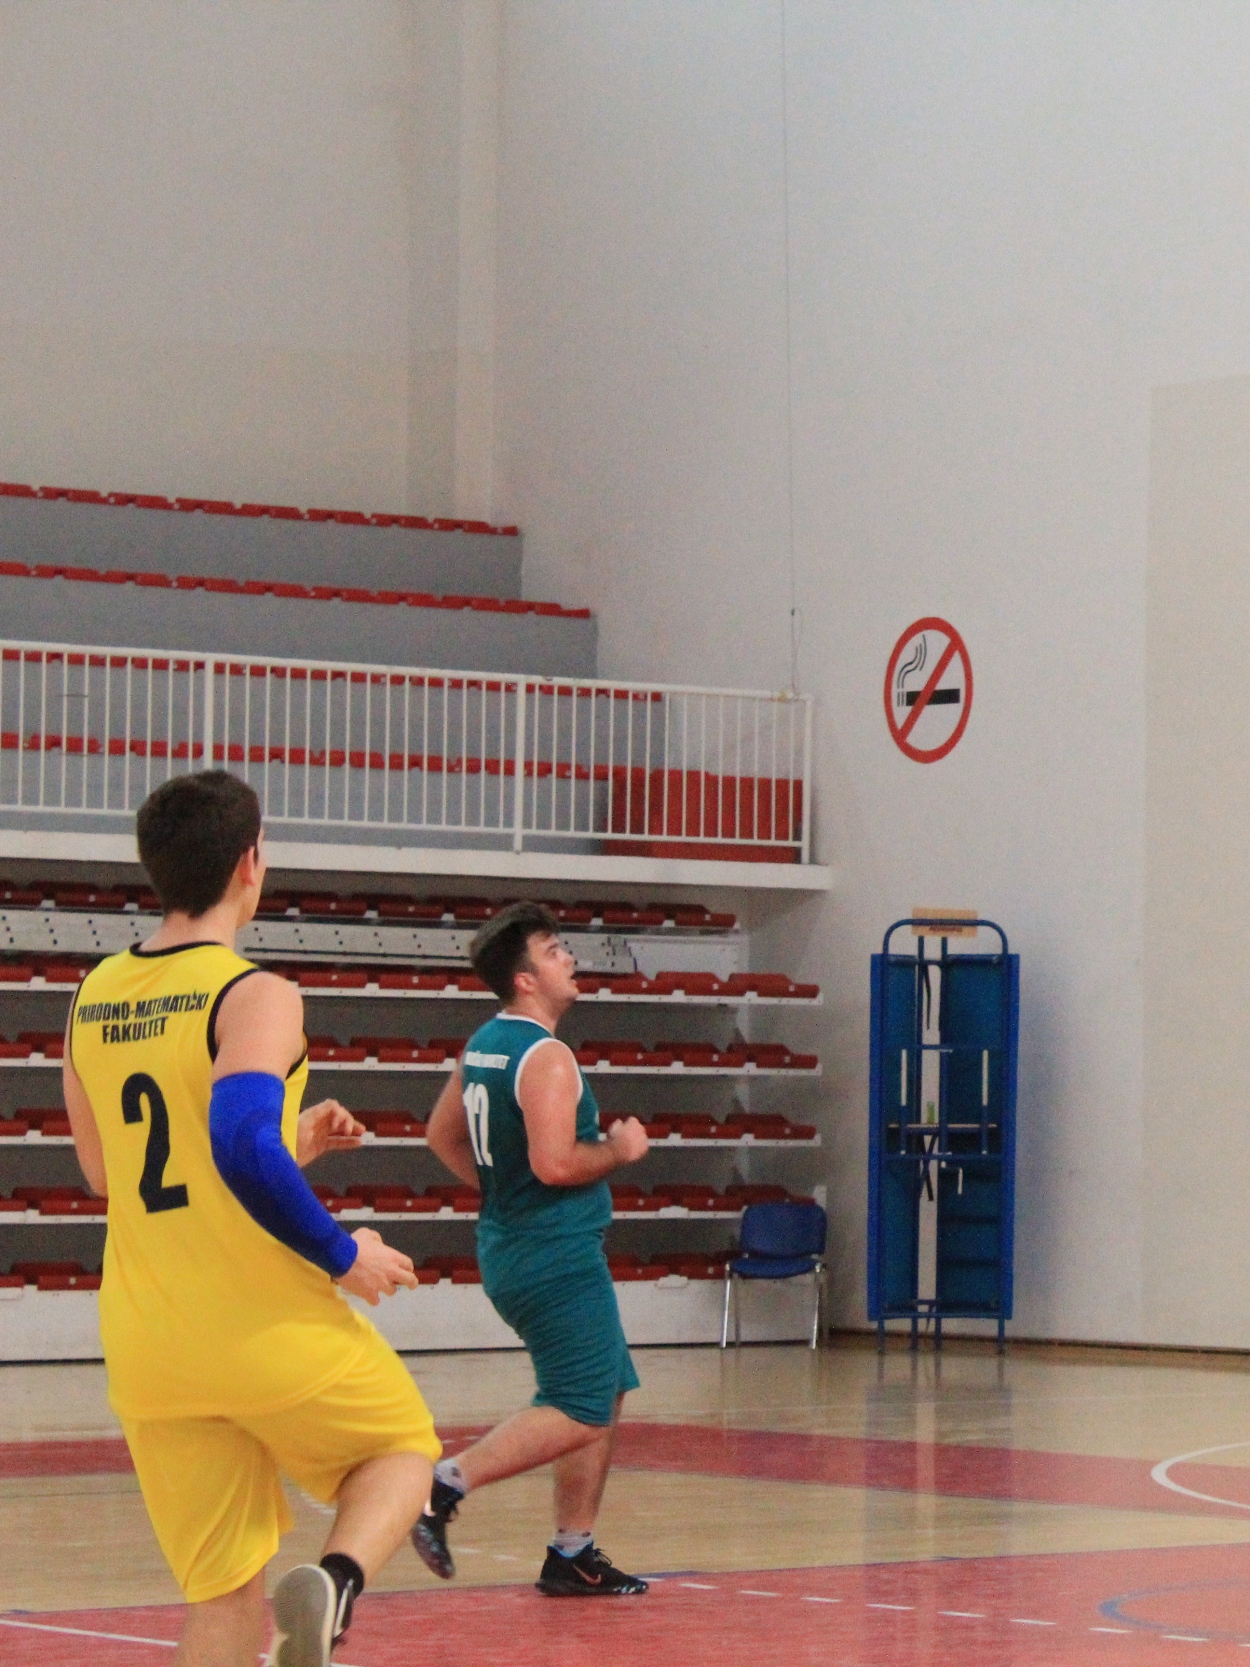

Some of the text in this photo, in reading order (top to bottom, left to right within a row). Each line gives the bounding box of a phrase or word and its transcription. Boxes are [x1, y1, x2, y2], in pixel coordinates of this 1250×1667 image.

[101, 1016, 169, 1045] FAKULTET
[121, 1072, 190, 1215] 2
[462, 1082, 494, 1168] 12
